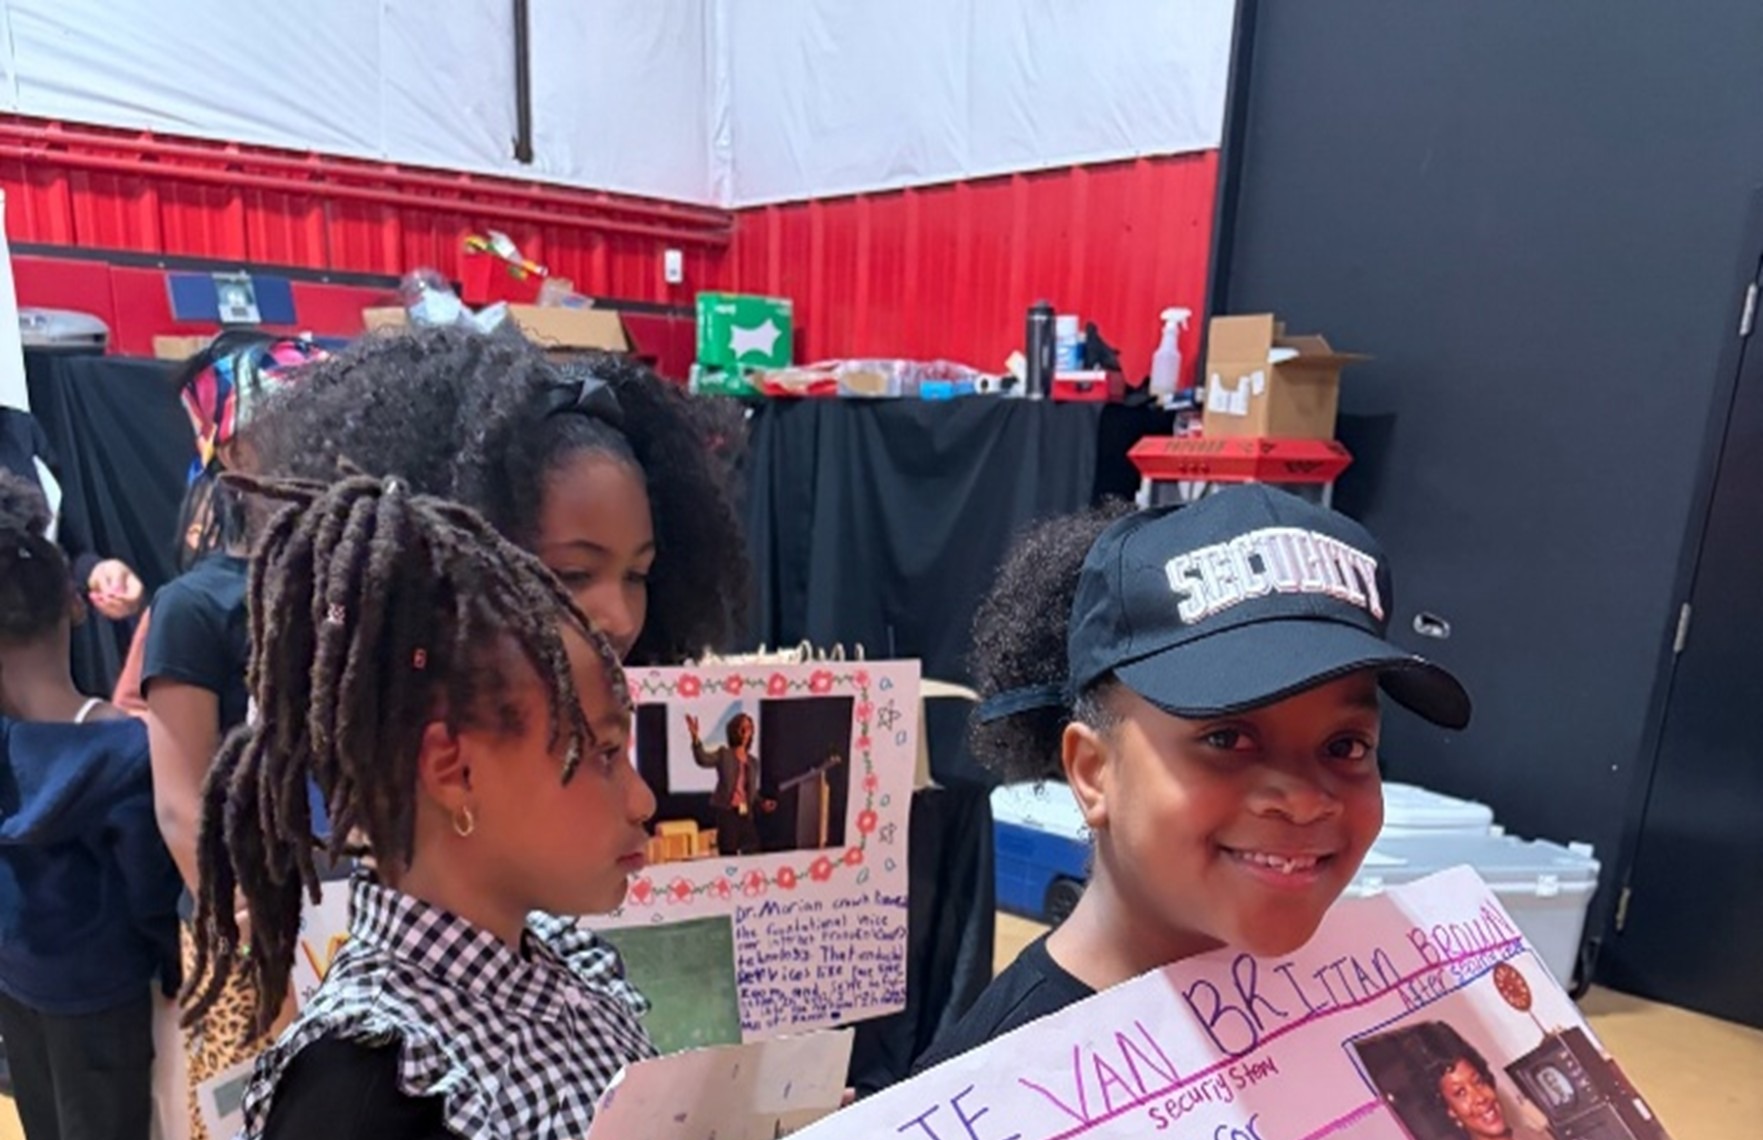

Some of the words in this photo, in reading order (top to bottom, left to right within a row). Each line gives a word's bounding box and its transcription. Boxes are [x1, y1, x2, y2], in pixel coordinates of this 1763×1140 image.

[1164, 526, 1385, 625] SECURITY
[1018, 1020, 1181, 1125] VAN
[1406, 899, 1516, 965] BROWN
